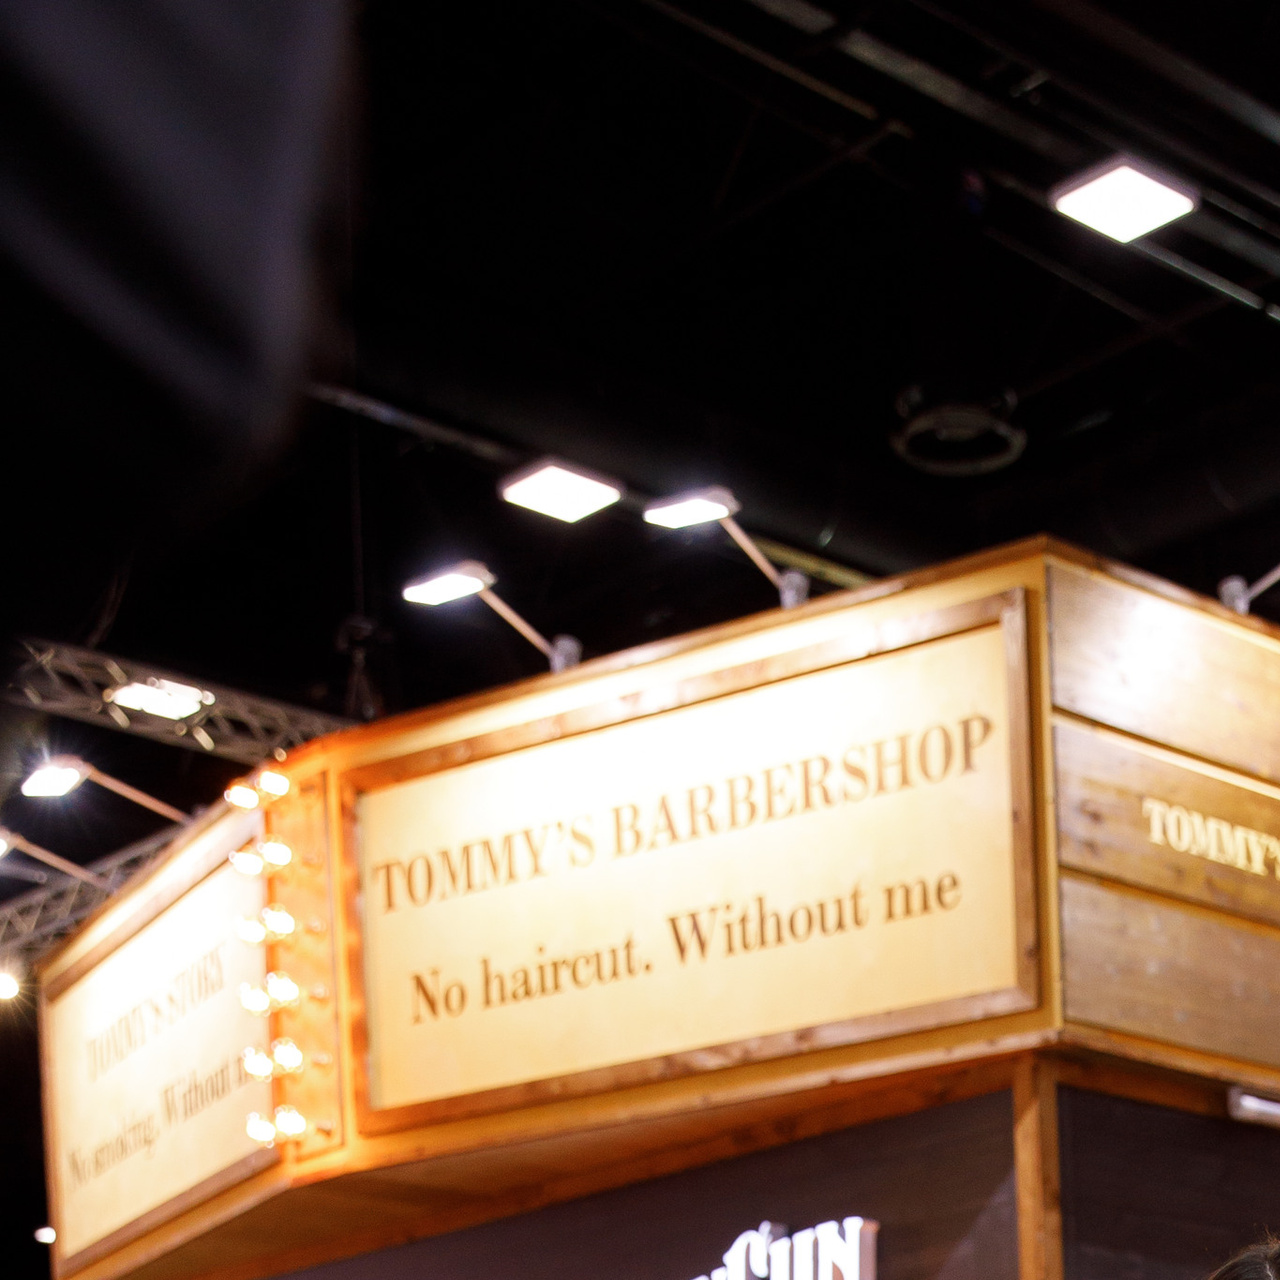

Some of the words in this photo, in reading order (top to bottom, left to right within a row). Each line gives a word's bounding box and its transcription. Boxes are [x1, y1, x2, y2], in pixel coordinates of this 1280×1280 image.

[371, 816, 597, 915] TOMMY'S
[611, 714, 993, 860] BARBERSHOP
[410, 967, 466, 1025] No
[481, 930, 653, 1010] haircut.
[667, 884, 868, 969] Without
[884, 870, 962, 925] me
